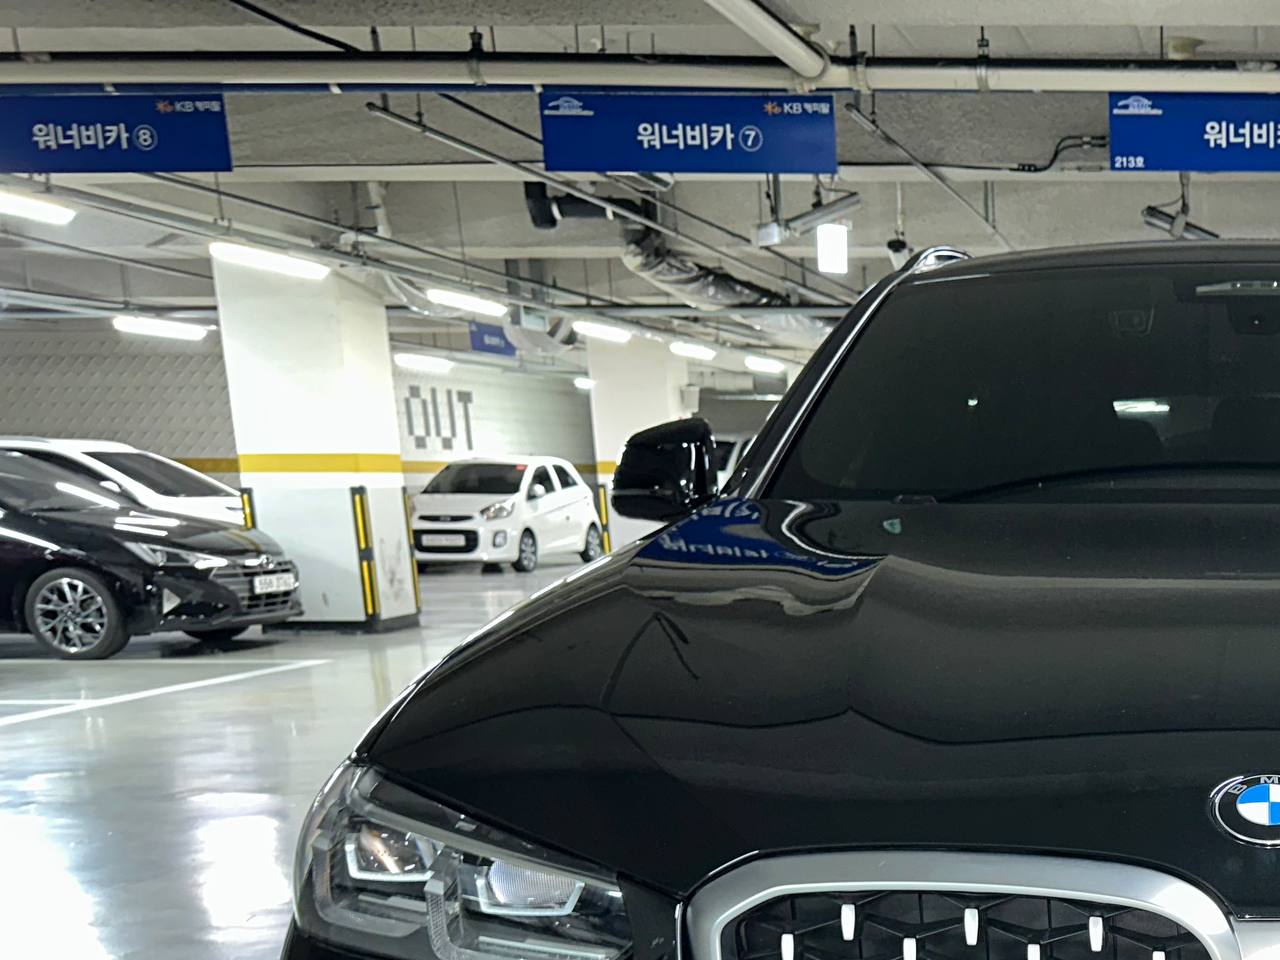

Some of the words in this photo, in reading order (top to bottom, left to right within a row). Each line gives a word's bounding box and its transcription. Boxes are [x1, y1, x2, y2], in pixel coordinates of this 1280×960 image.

[174, 101, 194, 112] KB
[783, 102, 802, 114] KB
[32, 123, 130, 149] 워너비카
[637, 122, 735, 150] 워너비카
[1114, 155, 1145, 168] 213호
[404, 385, 473, 450] OUT
